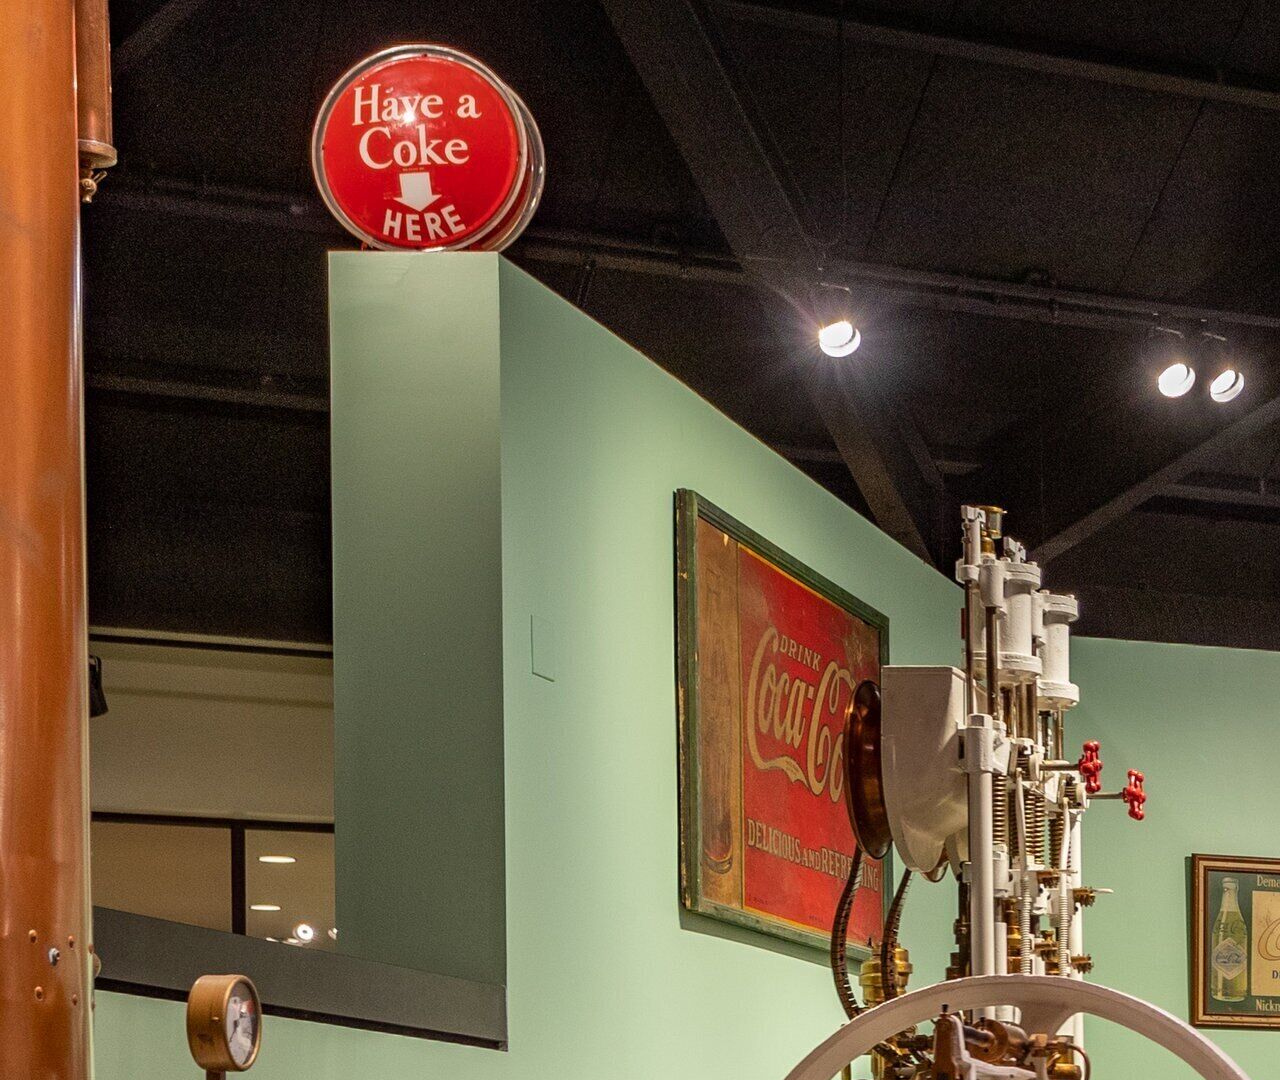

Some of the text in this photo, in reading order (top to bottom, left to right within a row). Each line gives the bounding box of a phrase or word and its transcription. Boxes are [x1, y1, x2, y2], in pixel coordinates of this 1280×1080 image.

[352, 83, 483, 126] Have a
[359, 123, 470, 170] Coke
[382, 204, 467, 241] HERE
[779, 634, 822, 672] DRINK
[746, 624, 857, 803] Coca-Co
[747, 818, 879, 892] DELICIOUS AND REFREING
